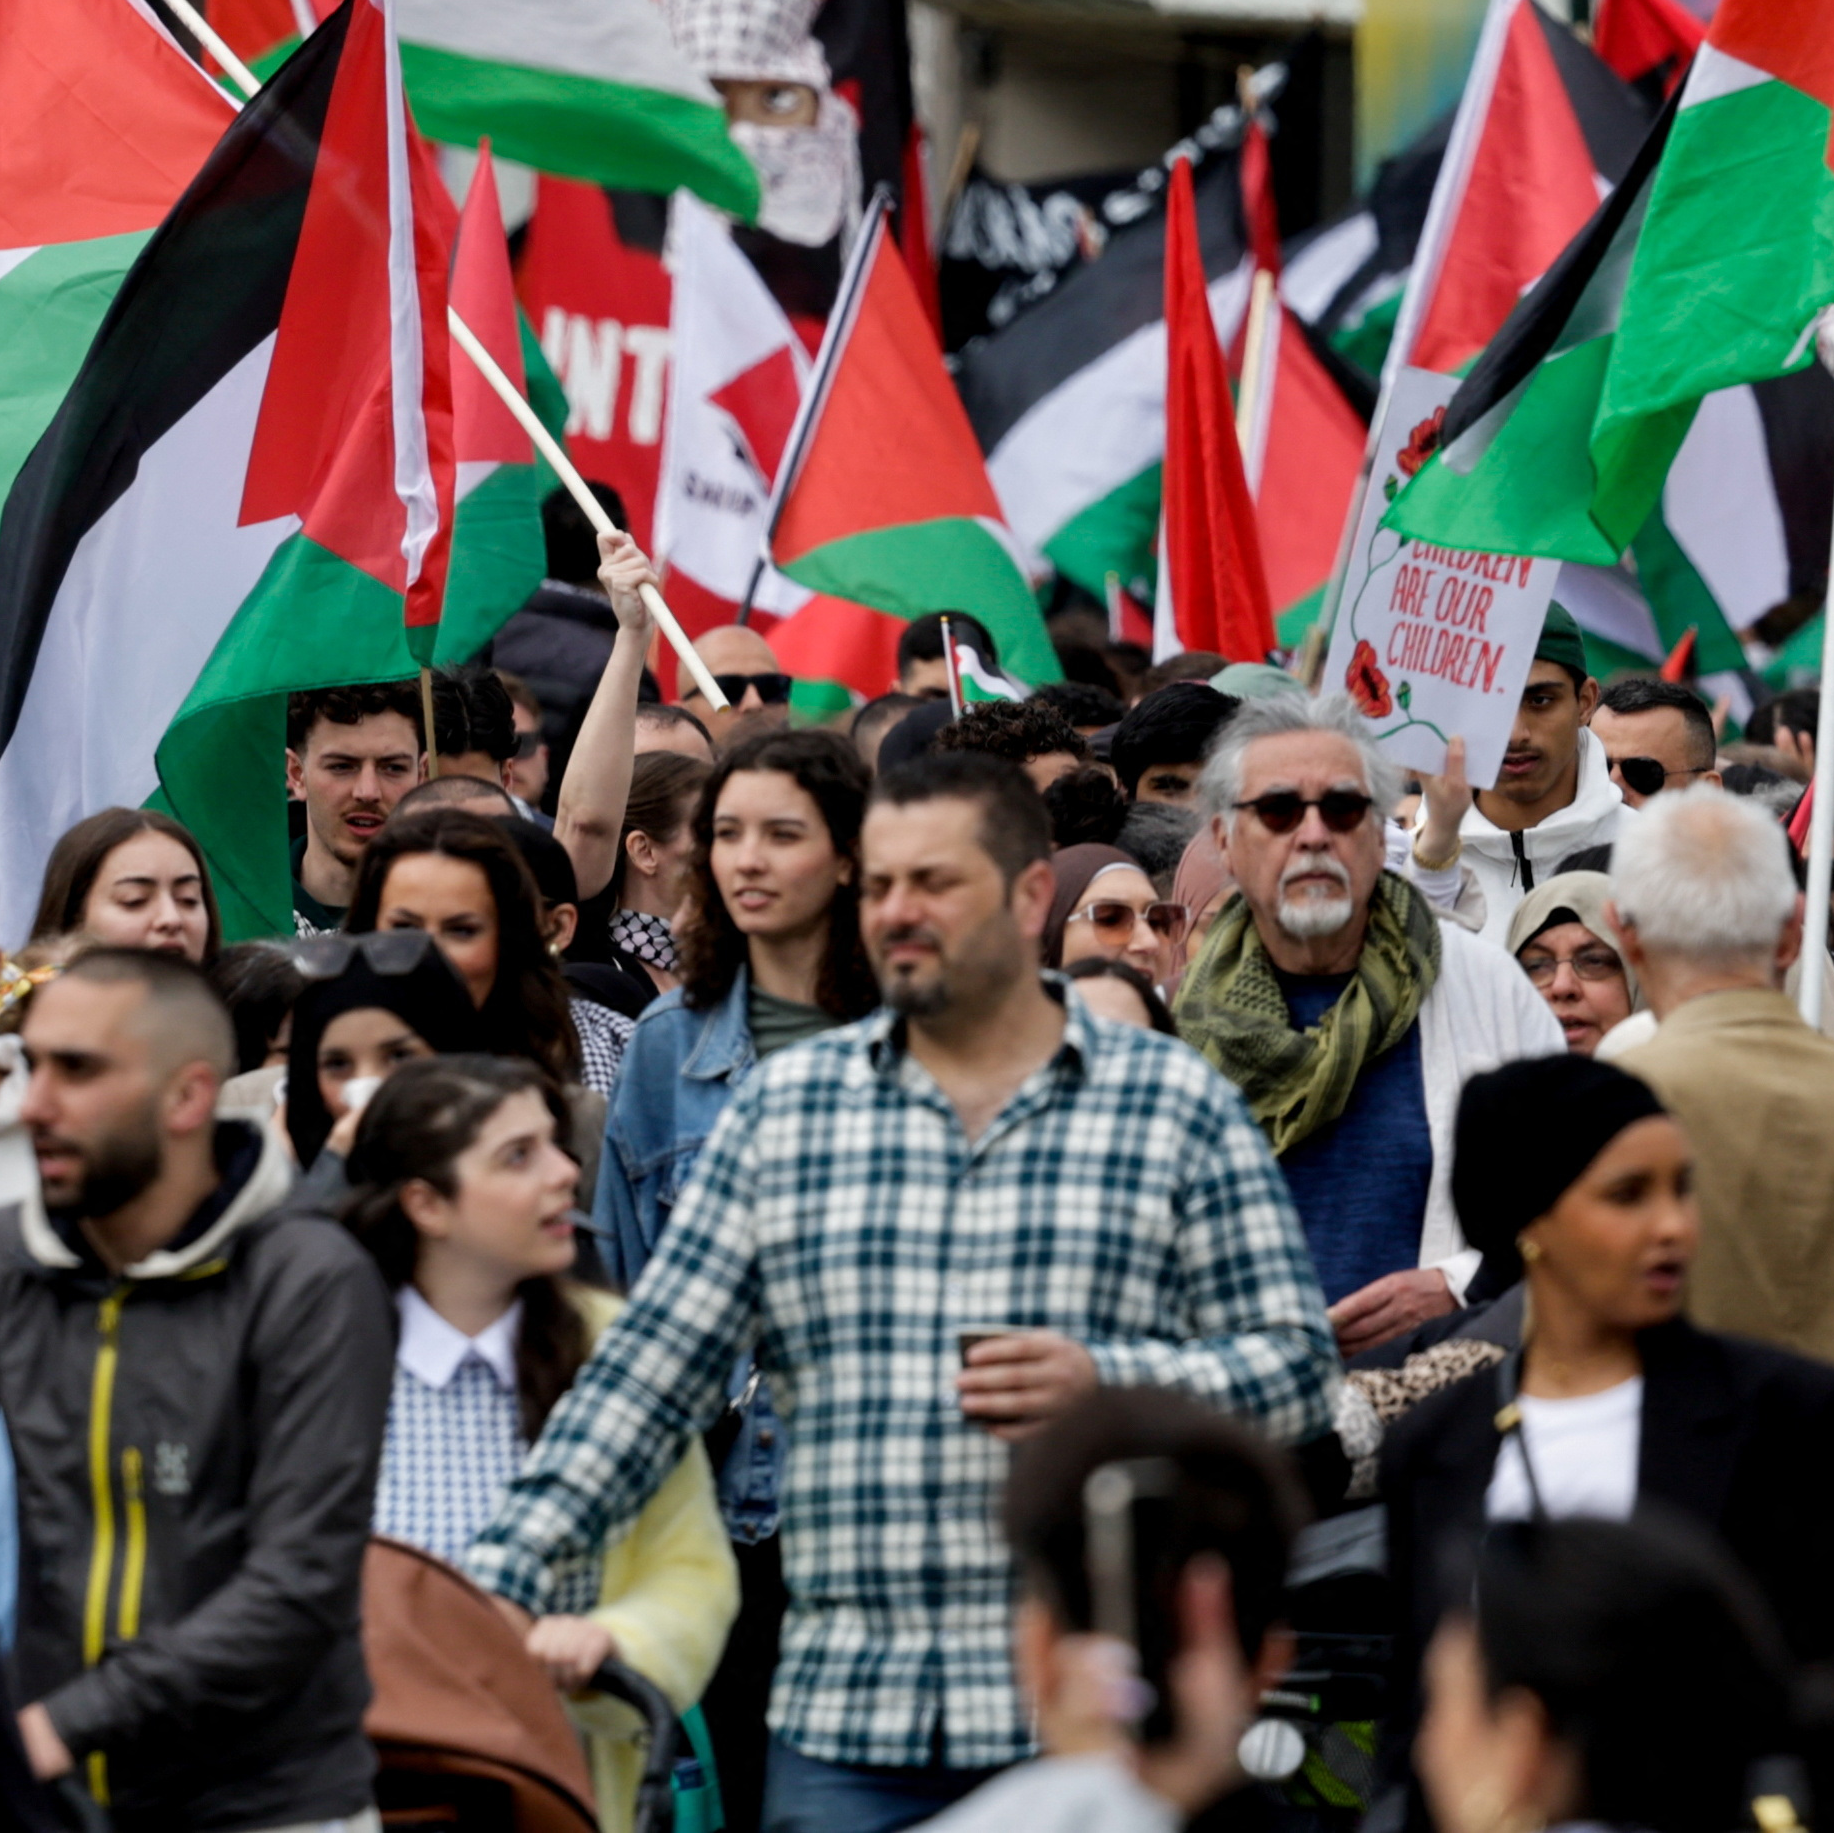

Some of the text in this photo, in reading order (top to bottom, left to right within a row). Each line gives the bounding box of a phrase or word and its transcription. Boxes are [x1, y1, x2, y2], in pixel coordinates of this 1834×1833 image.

[1388, 562, 1495, 634] ARE OUR
[1386, 621, 1506, 695] CHILDREN.
